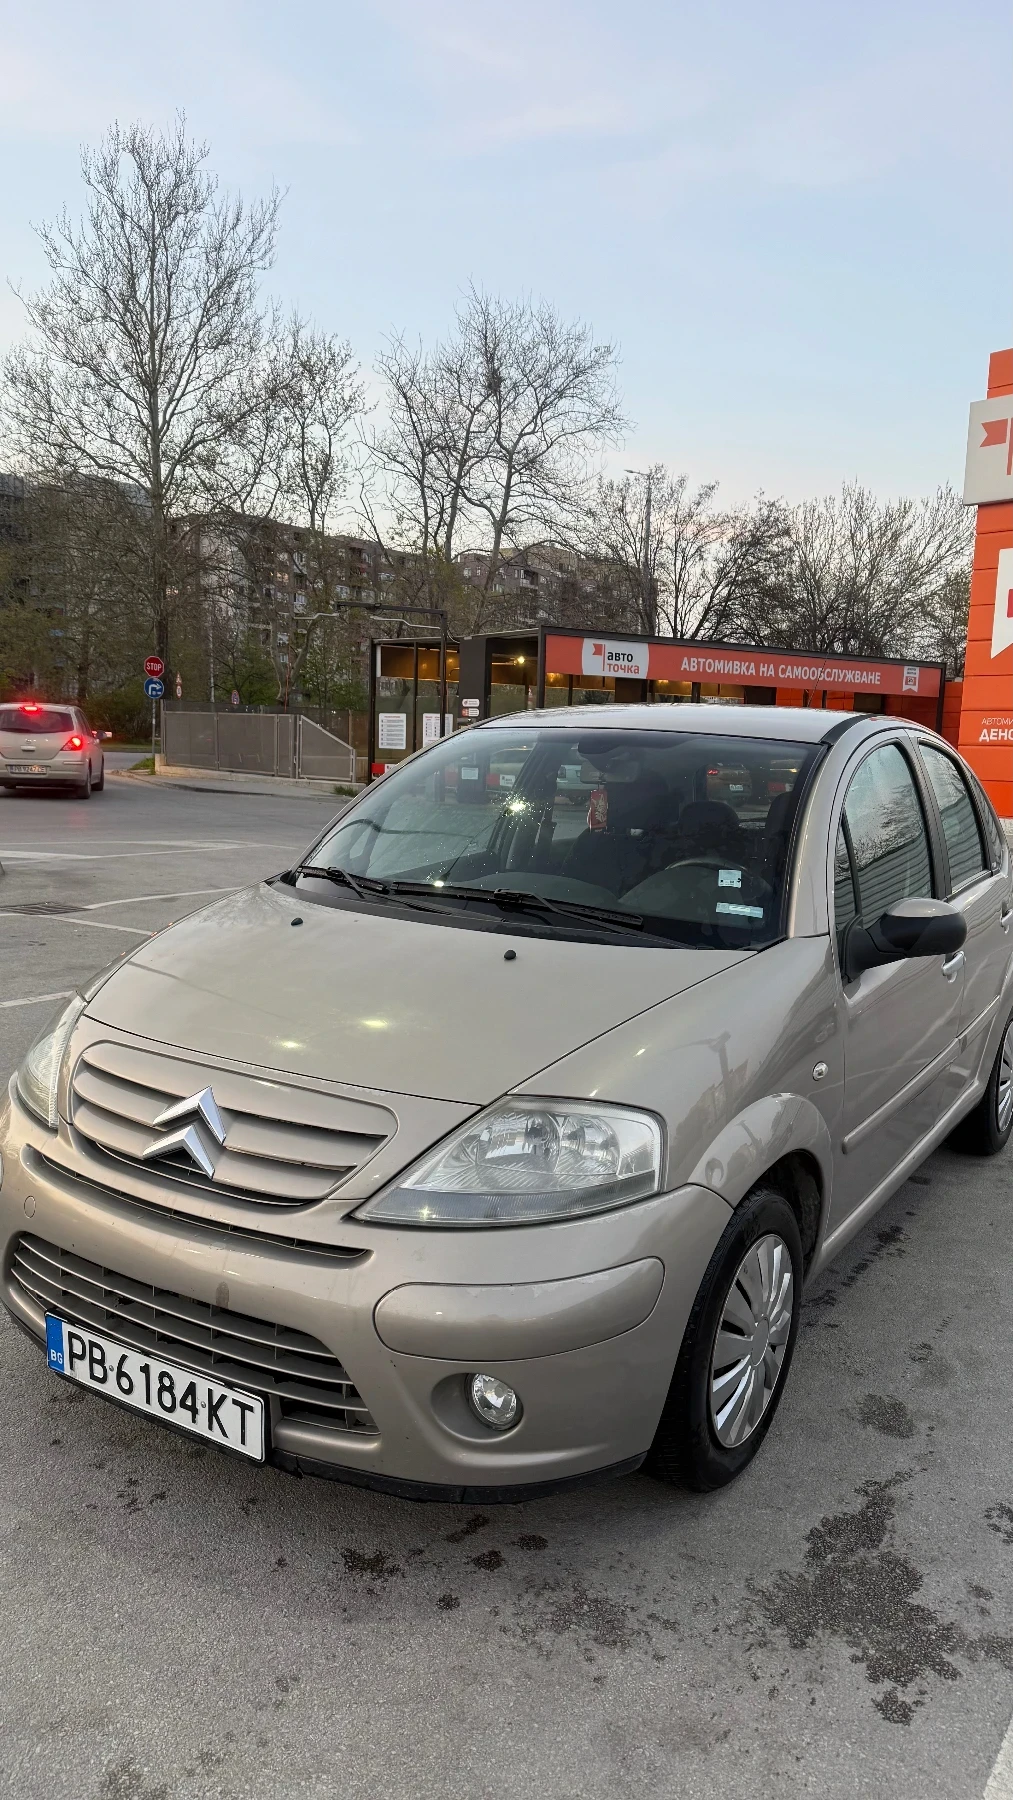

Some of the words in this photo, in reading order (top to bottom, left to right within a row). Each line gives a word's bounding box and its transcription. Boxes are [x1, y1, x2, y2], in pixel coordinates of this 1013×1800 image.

[607, 650, 633, 663] авто
[146, 661, 162, 671] STOP
[607, 662, 640, 675] точка
[681, 656, 756, 676] АВТОМИВКА
[759, 663, 775, 678] НА
[778, 664, 881, 685] САМООБСЛУЖВАНЕ
[50, 1349, 63, 1364] BG
[116, 1353, 199, 1424] 6184
